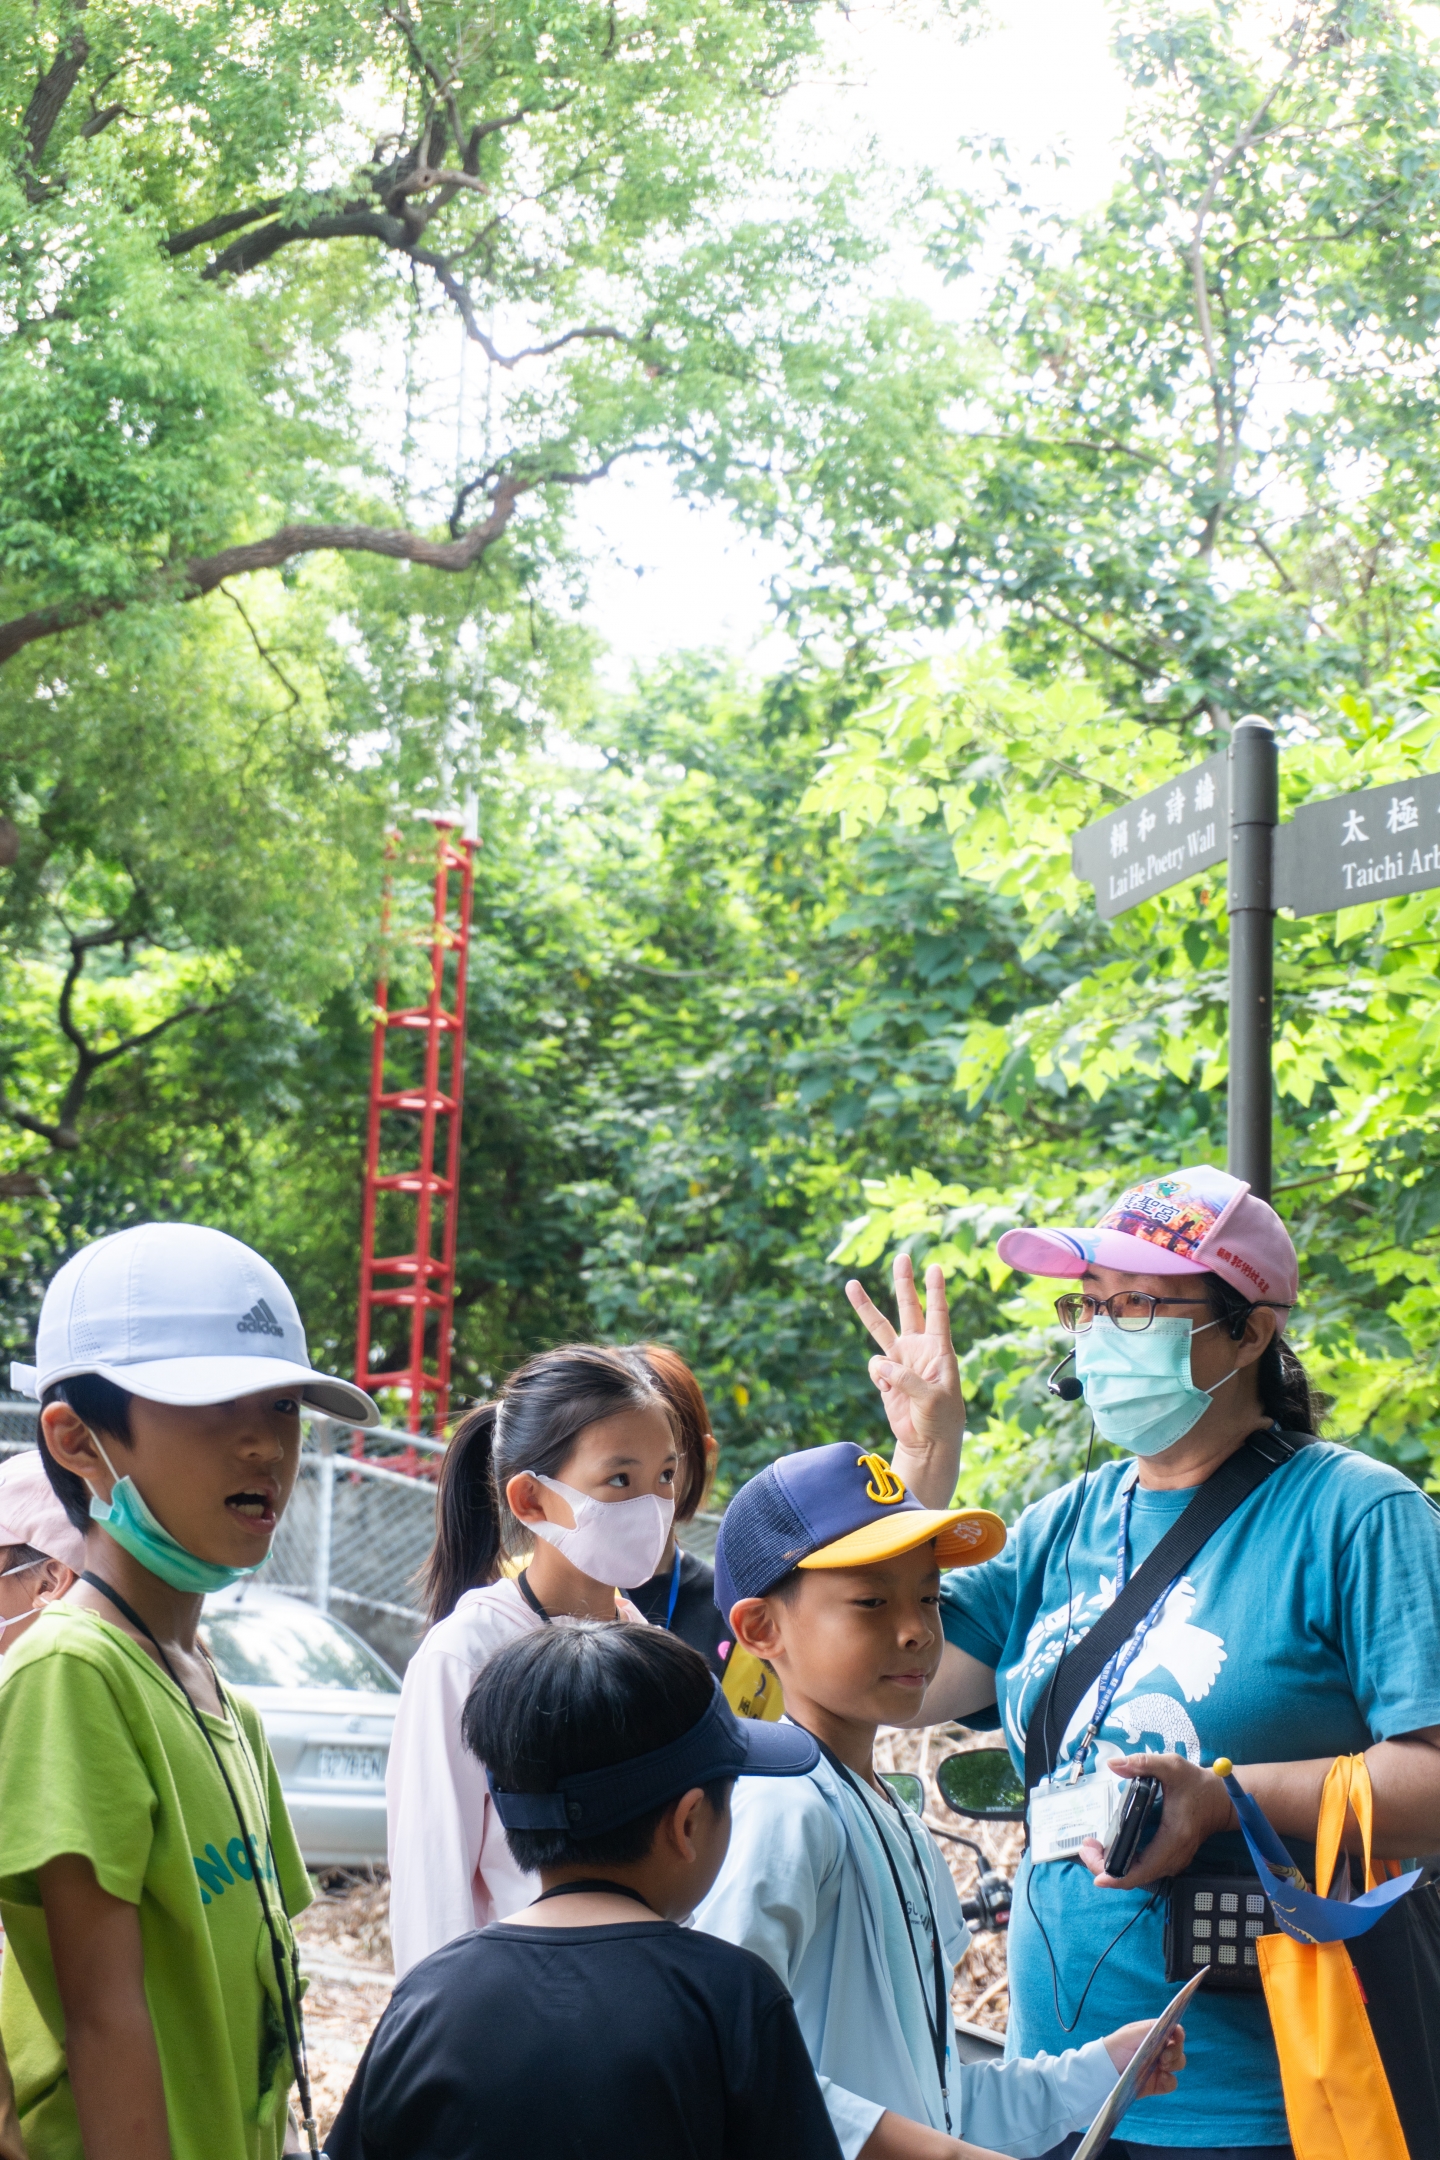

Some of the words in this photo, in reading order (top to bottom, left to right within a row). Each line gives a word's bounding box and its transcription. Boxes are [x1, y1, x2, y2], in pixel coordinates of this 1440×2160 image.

[1341, 796, 1440, 846] 太極
[1109, 868, 1128, 900] Lai
[1129, 862, 1146, 890] He
[1147, 845, 1185, 880] Poetry
[1187, 822, 1215, 857] Wall
[1342, 851, 1404, 889] Taichi
[237, 1320, 284, 1338] adidas
